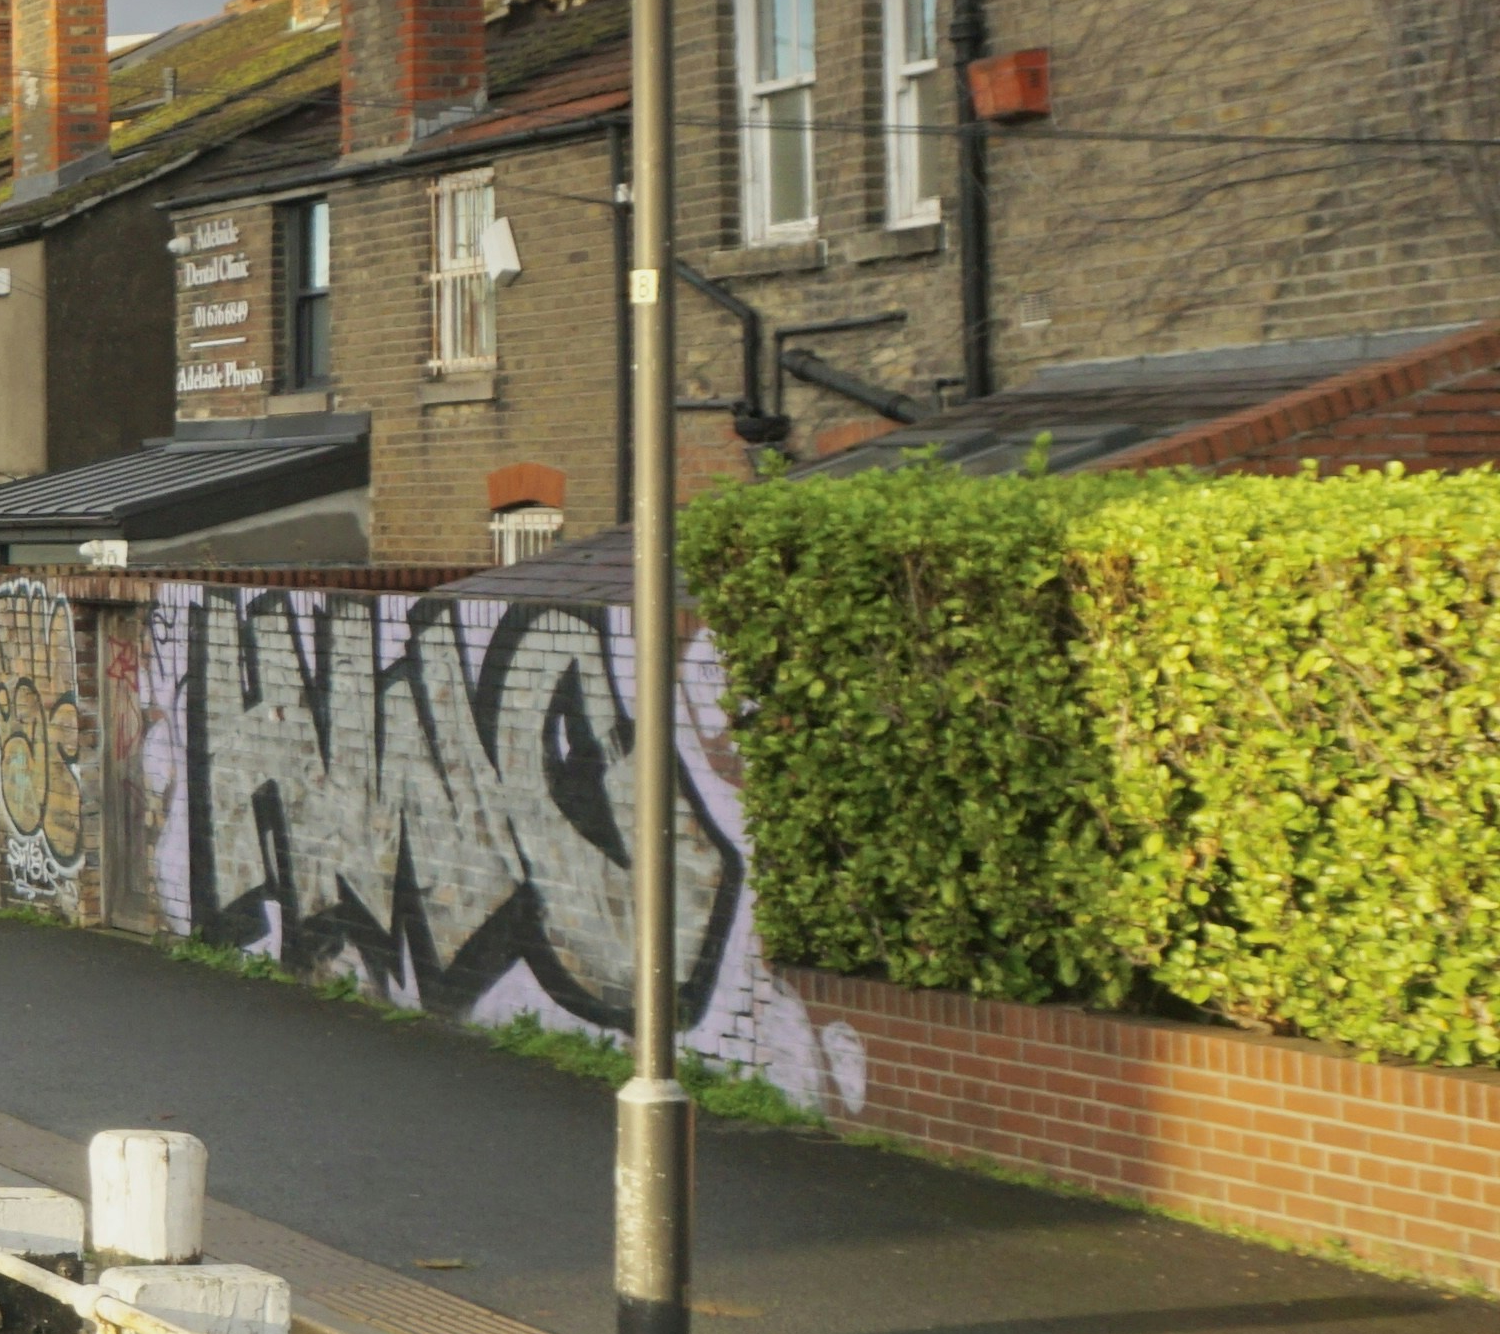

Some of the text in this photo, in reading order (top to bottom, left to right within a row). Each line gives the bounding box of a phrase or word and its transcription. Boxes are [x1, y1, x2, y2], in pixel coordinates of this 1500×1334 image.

[195, 218, 240, 250] Adelaide
[184, 252, 251, 287] Dental Clinic
[176, 360, 264, 392] Adelaide Physio
